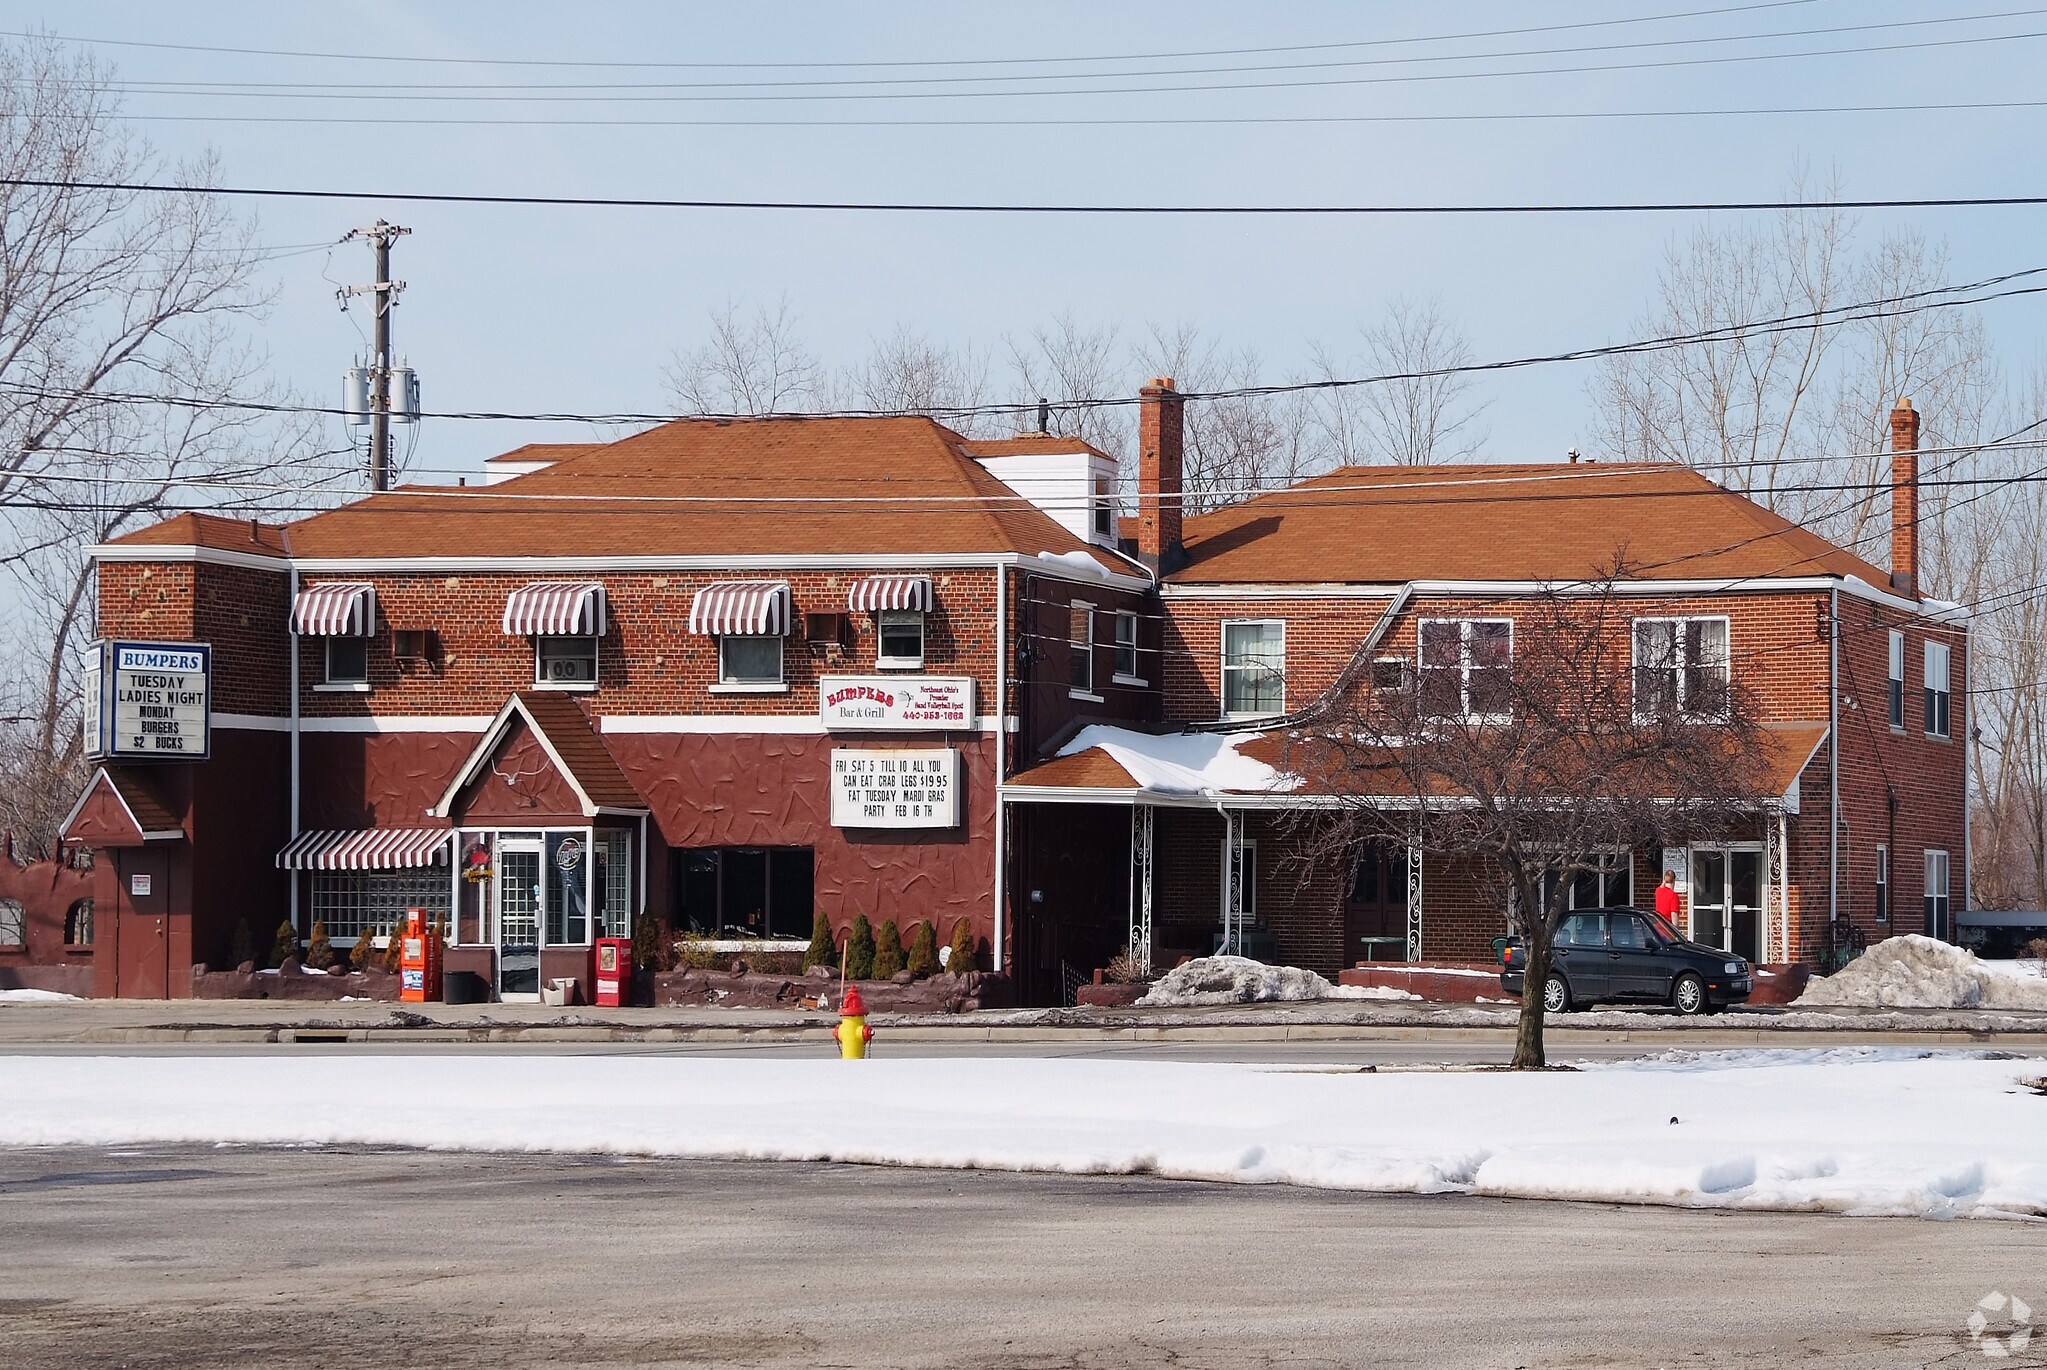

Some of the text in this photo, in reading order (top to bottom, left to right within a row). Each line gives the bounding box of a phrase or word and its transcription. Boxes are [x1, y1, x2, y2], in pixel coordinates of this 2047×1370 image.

[124, 653, 199, 669] BUMPERS
[131, 675, 185, 689] TUESDAY
[119, 690, 203, 704] LADIES NIGHT
[826, 686, 894, 708] BUMPERS
[139, 706, 174, 718] MONDAY
[840, 707, 885, 718] Bar & Grill
[141, 721, 179, 734] BURGERS
[156, 737, 183, 749] BUCKS
[835, 760, 847, 772] FRI
[852, 760, 865, 772] SAT
[870, 760, 874, 772] 5
[881, 760, 895, 772] TILL
[913, 760, 924, 772] ALL
[928, 760, 941, 772] YOU
[844, 775, 856, 787] CAN
[860, 775, 873, 787] EAT
[878, 775, 896, 787] CRAB
[901, 775, 917, 787] LEGS
[849, 790, 944, 802] FAT TUESDAY MARDI GRAS
[864, 805, 932, 817] PARTY FEB 16 TH
